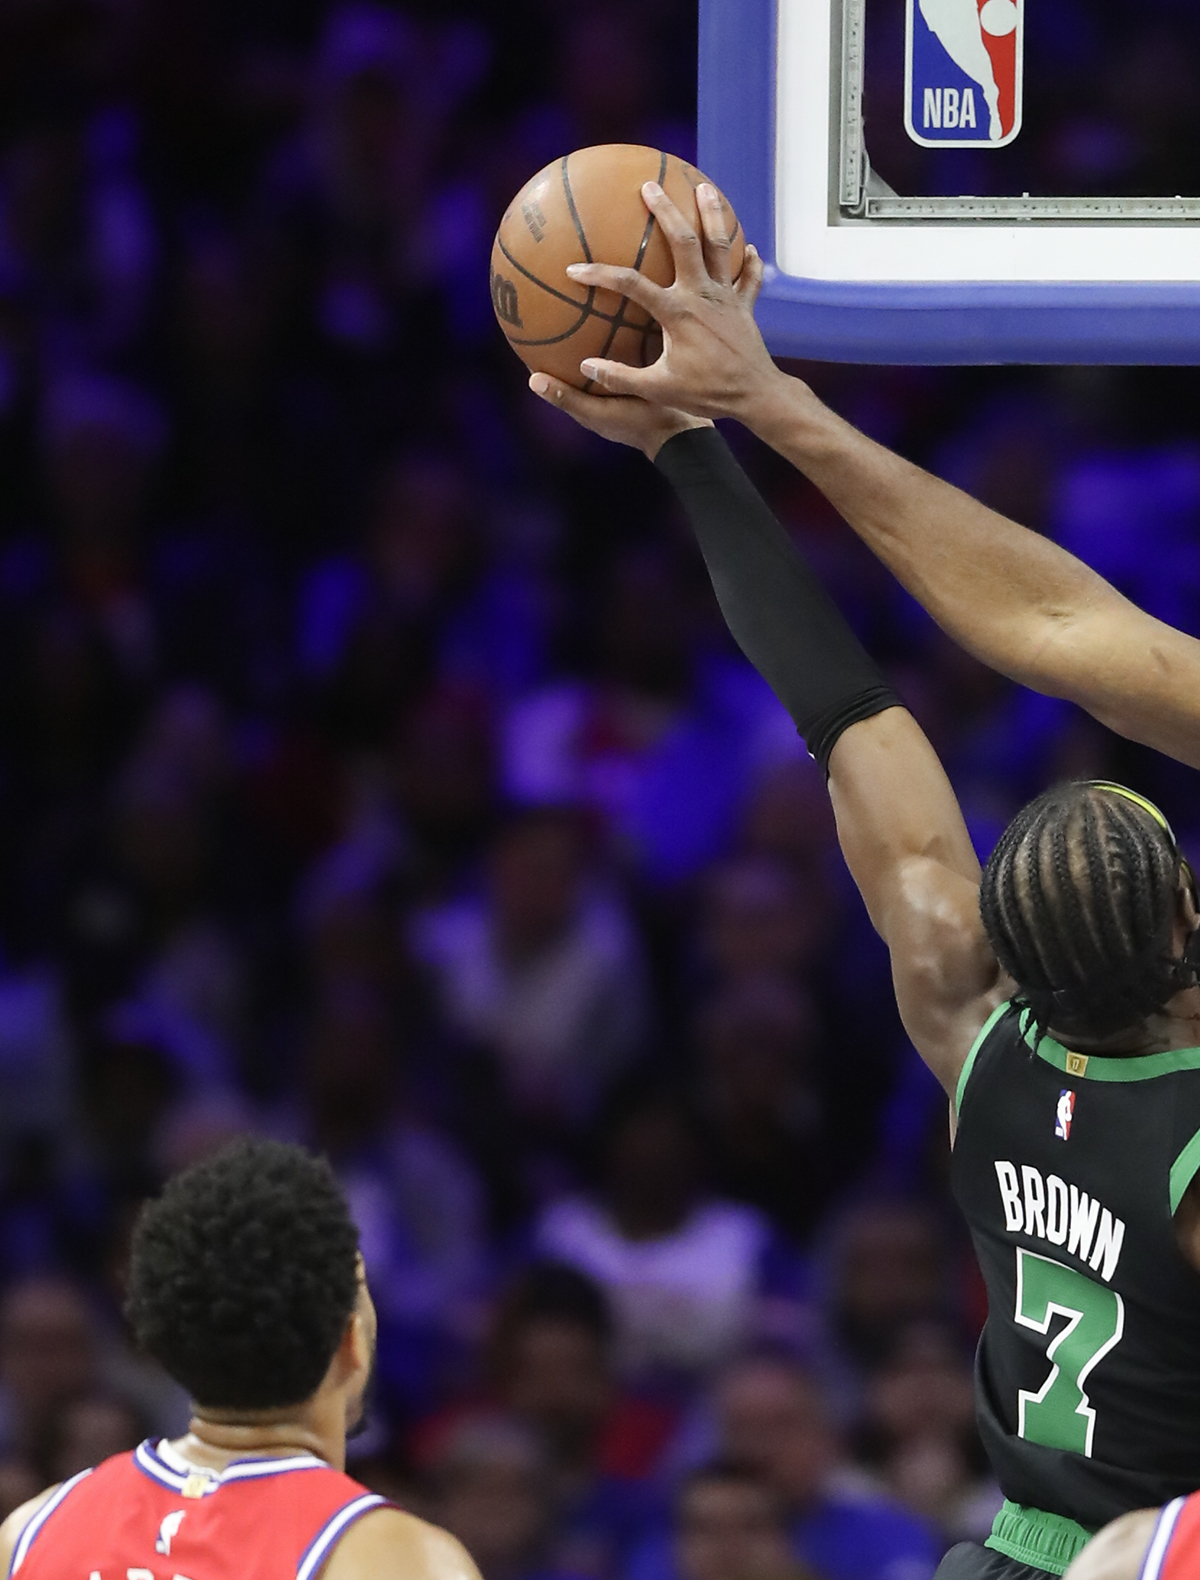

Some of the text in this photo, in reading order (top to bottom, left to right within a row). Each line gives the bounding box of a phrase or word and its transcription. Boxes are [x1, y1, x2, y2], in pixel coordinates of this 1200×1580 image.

[923, 87, 977, 129] NBA
[994, 1160, 1126, 1282] BROWN
[1014, 1246, 1125, 1459] 7
